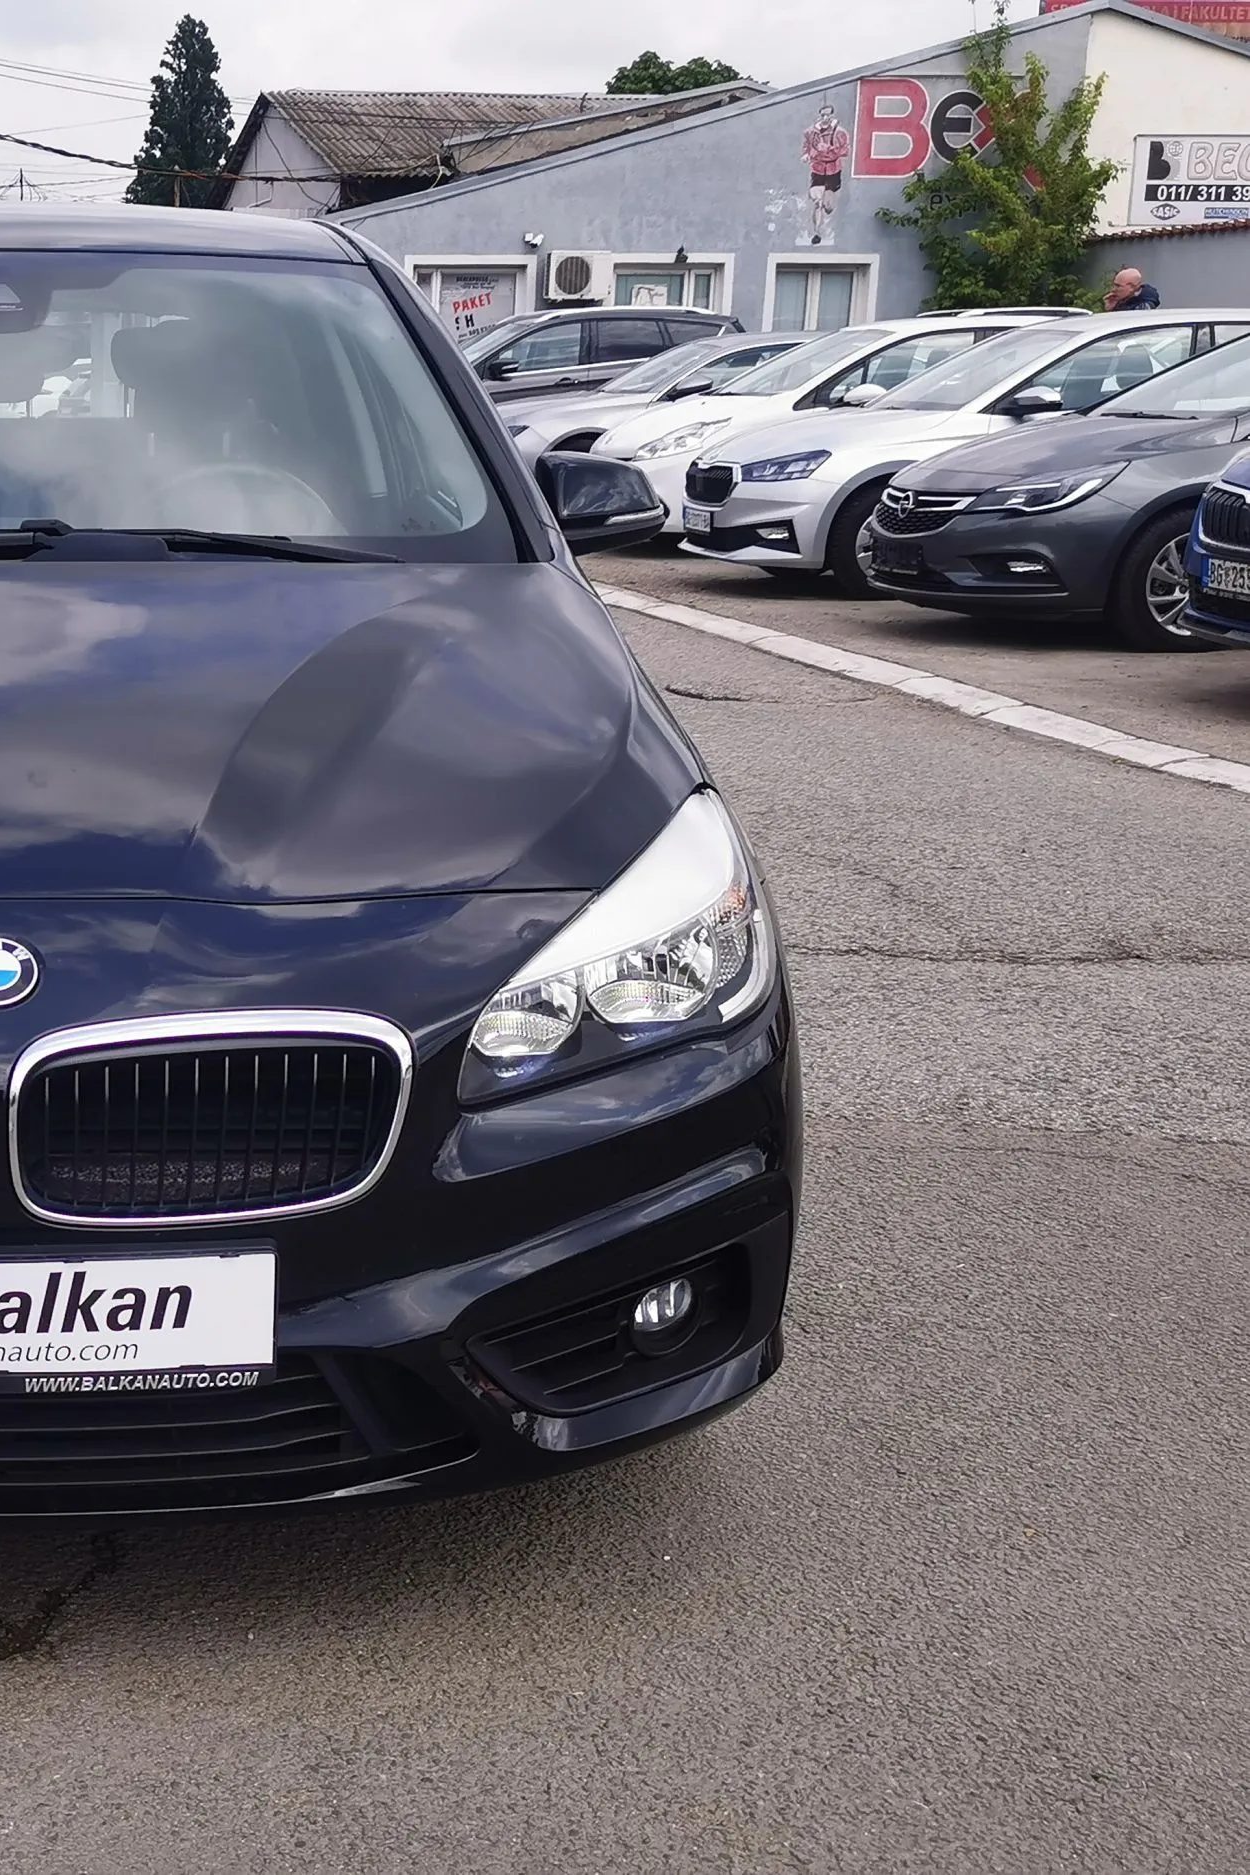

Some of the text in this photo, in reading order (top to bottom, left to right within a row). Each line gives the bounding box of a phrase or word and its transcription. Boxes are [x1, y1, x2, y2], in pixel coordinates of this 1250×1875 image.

[1197, 186, 1226, 201] 311
[452, 292, 492, 314] PAKET
[24, 1371, 260, 1393] WWW.BALKANAUTO.COM
